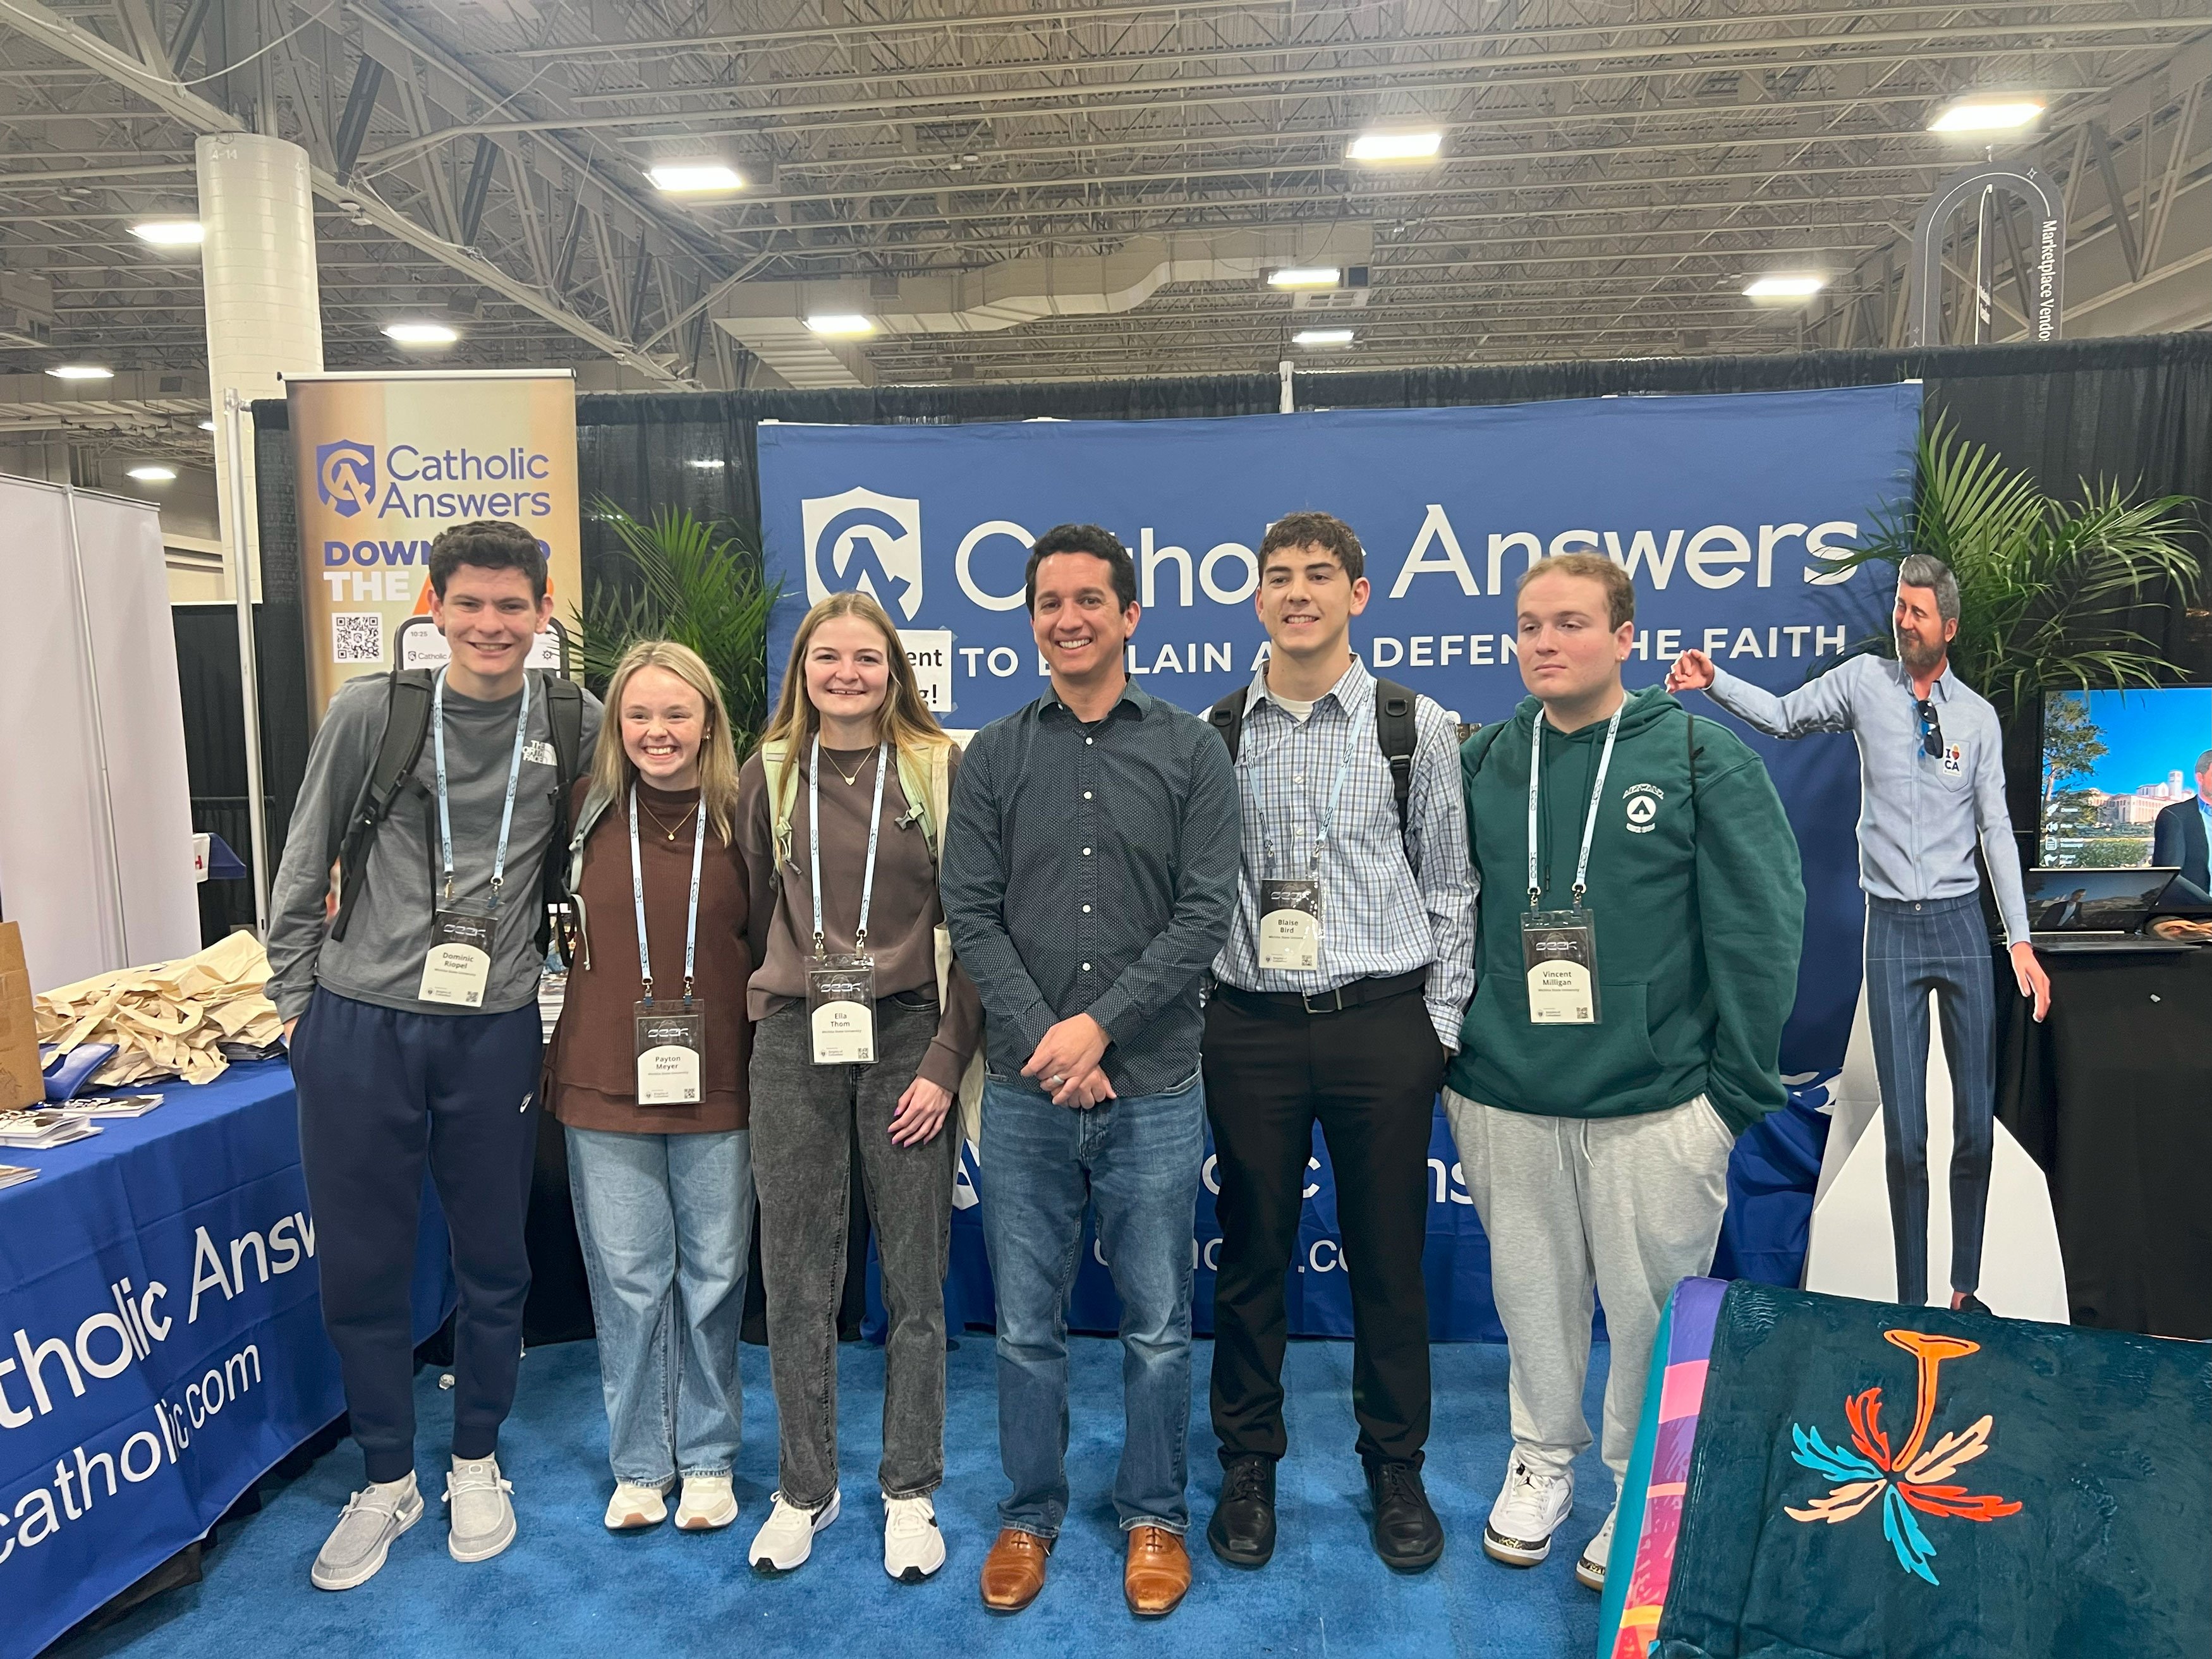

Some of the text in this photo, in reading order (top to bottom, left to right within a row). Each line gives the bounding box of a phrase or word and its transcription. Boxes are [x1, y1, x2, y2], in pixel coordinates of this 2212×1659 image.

[2038, 220, 2057, 342] Marketplace Vendo
[387, 444, 549, 480] Catholic
[377, 482, 551, 519] Answers
[323, 571, 410, 602] THE
[959, 646, 1019, 678] TO
[1373, 633, 1518, 667] DEFEN
[1631, 628, 1682, 660] HE
[1703, 624, 1846, 659] FAITH
[1945, 760, 1960, 772] CA
[442, 952, 474, 963] Dominic
[444, 961, 468, 969] Riopel
[655, 1056, 681, 1064] Payton
